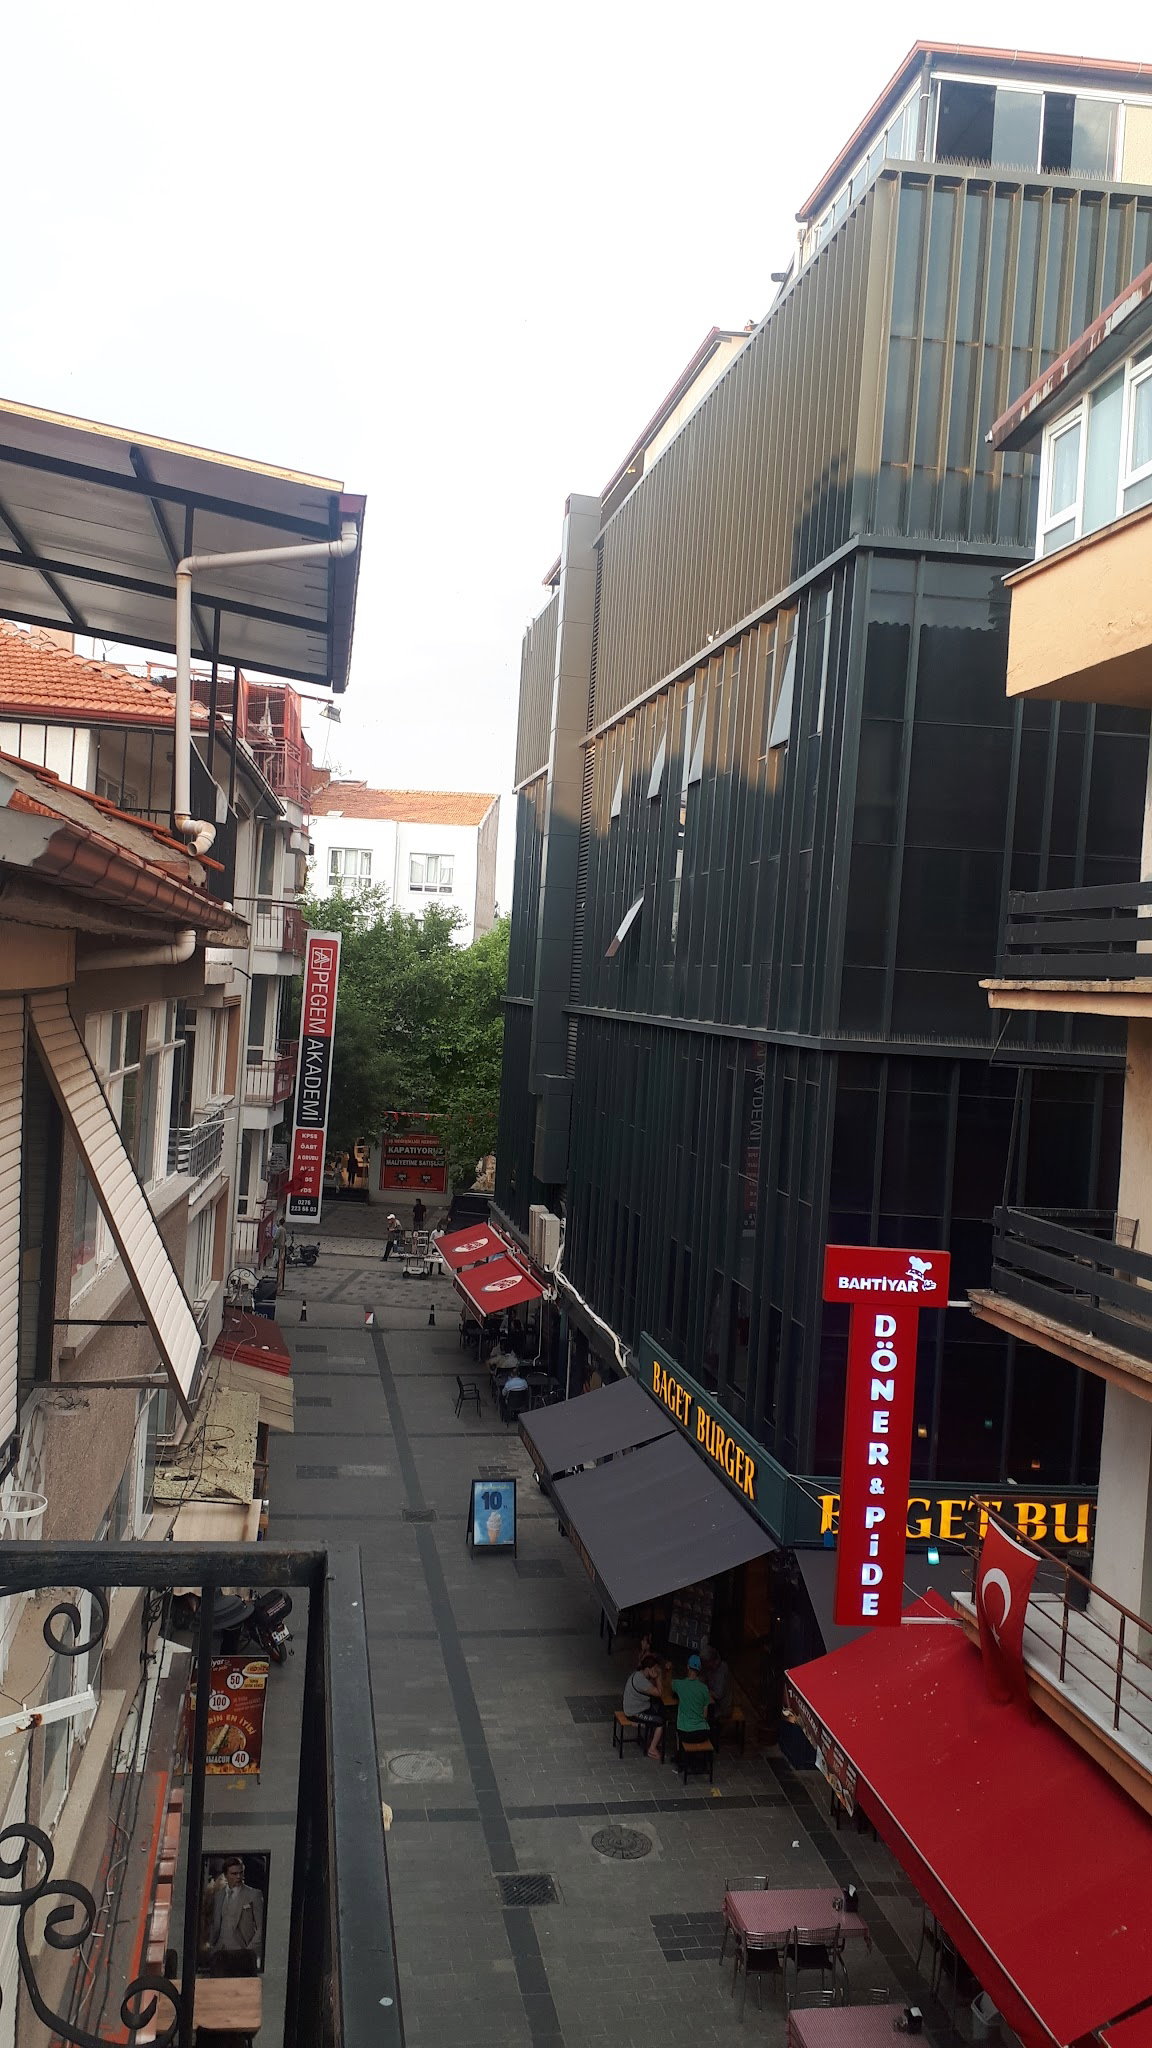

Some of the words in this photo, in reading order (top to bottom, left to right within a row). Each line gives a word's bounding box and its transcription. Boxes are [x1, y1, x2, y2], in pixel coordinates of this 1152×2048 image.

[308, 971, 330, 1034] PEGEM
[302, 1038, 324, 1121] AKADEMİ
[388, 1146, 444, 1155] KAPATIYORUZ
[838, 1276, 919, 1293] BAHTİYAR
[867, 1314, 898, 1466] DÖNER
[652, 1361, 692, 1426] BAGET
[696, 1405, 755, 1500] BURGER
[869, 1477, 885, 1494] &
[481, 1491, 503, 1511] 10
[817, 1494, 1002, 1542] BGET
[1013, 1501, 1092, 1544] BU
[230, 1675, 240, 1685] 50
[212, 1697, 227, 1707] 100
[235, 1753, 246, 1763] 40
